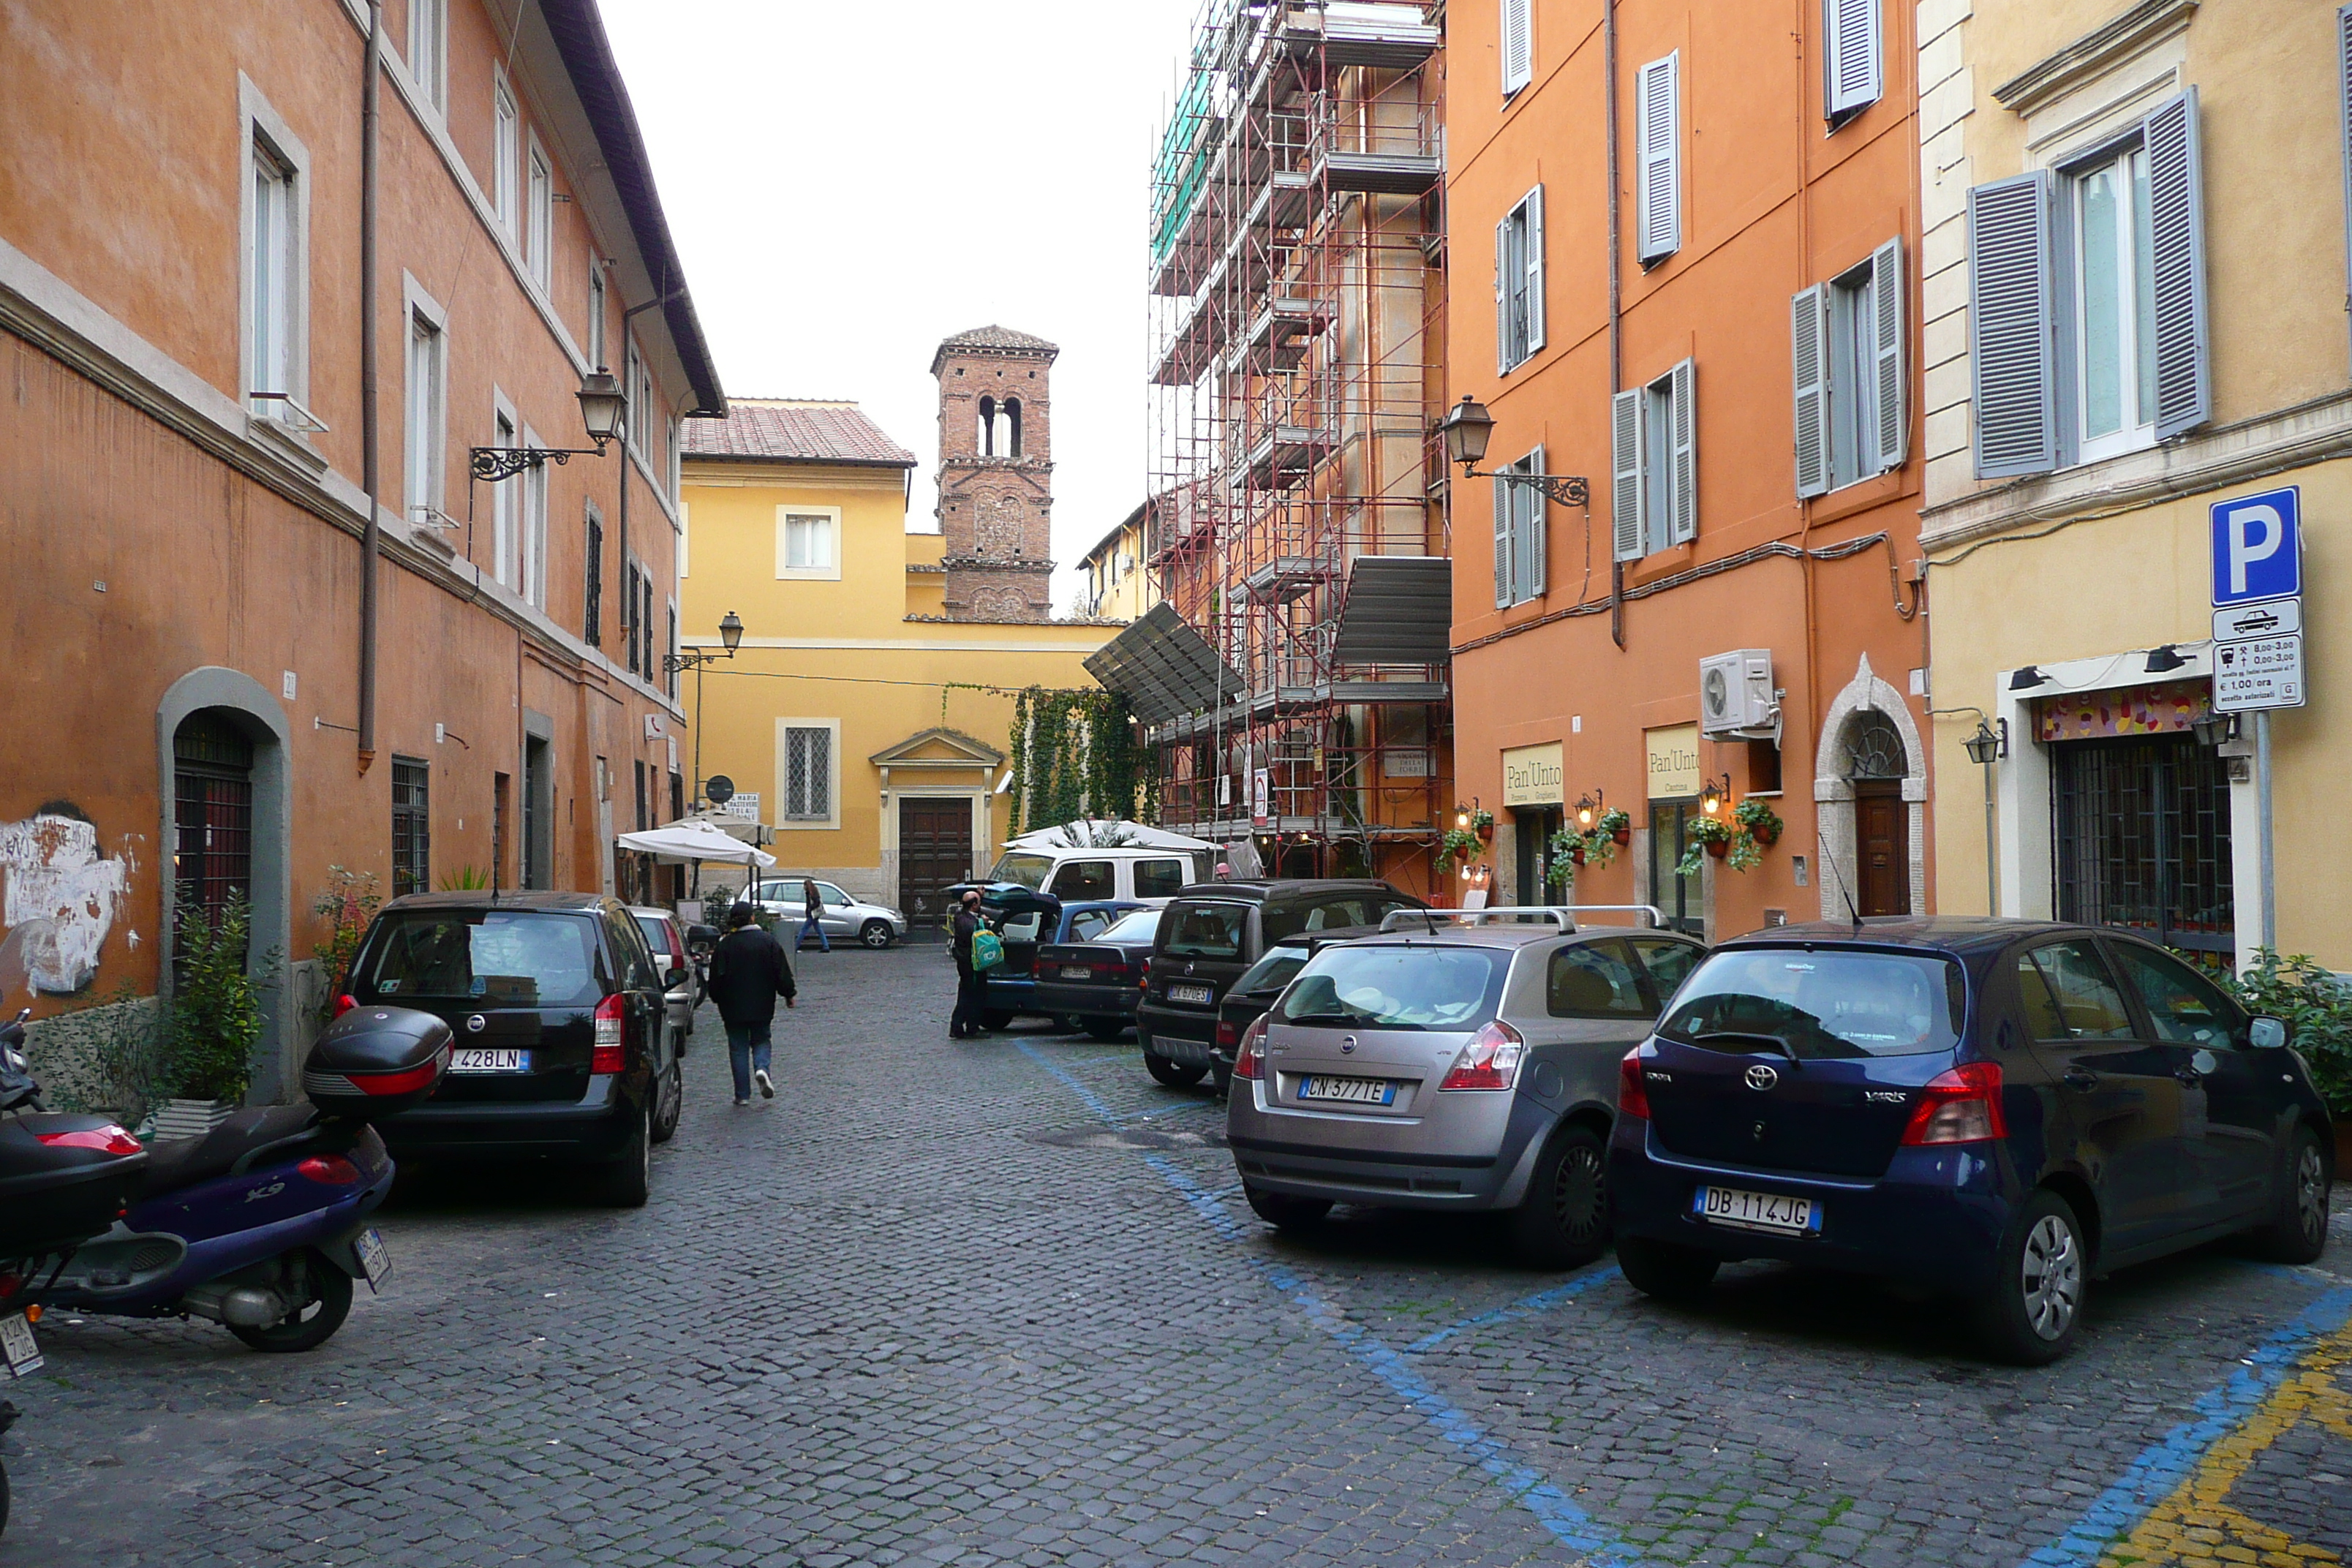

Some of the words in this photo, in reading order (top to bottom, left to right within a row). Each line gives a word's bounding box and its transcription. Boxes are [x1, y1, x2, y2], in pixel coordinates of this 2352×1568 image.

[2228, 505, 2283, 594] P
[2220, 682, 2227, 691] €
[2222, 694, 2242, 703] eccetto
[2244, 690, 2275, 701] autorizzati
[2285, 685, 2292, 693] G
[1507, 761, 1561, 788] Pan'Unto
[1308, 1077, 1328, 1096] CN
[1331, 1079, 1384, 1101] 377TE
[1707, 1189, 1732, 1214] DB
[1741, 1195, 1809, 1225] 114JG
